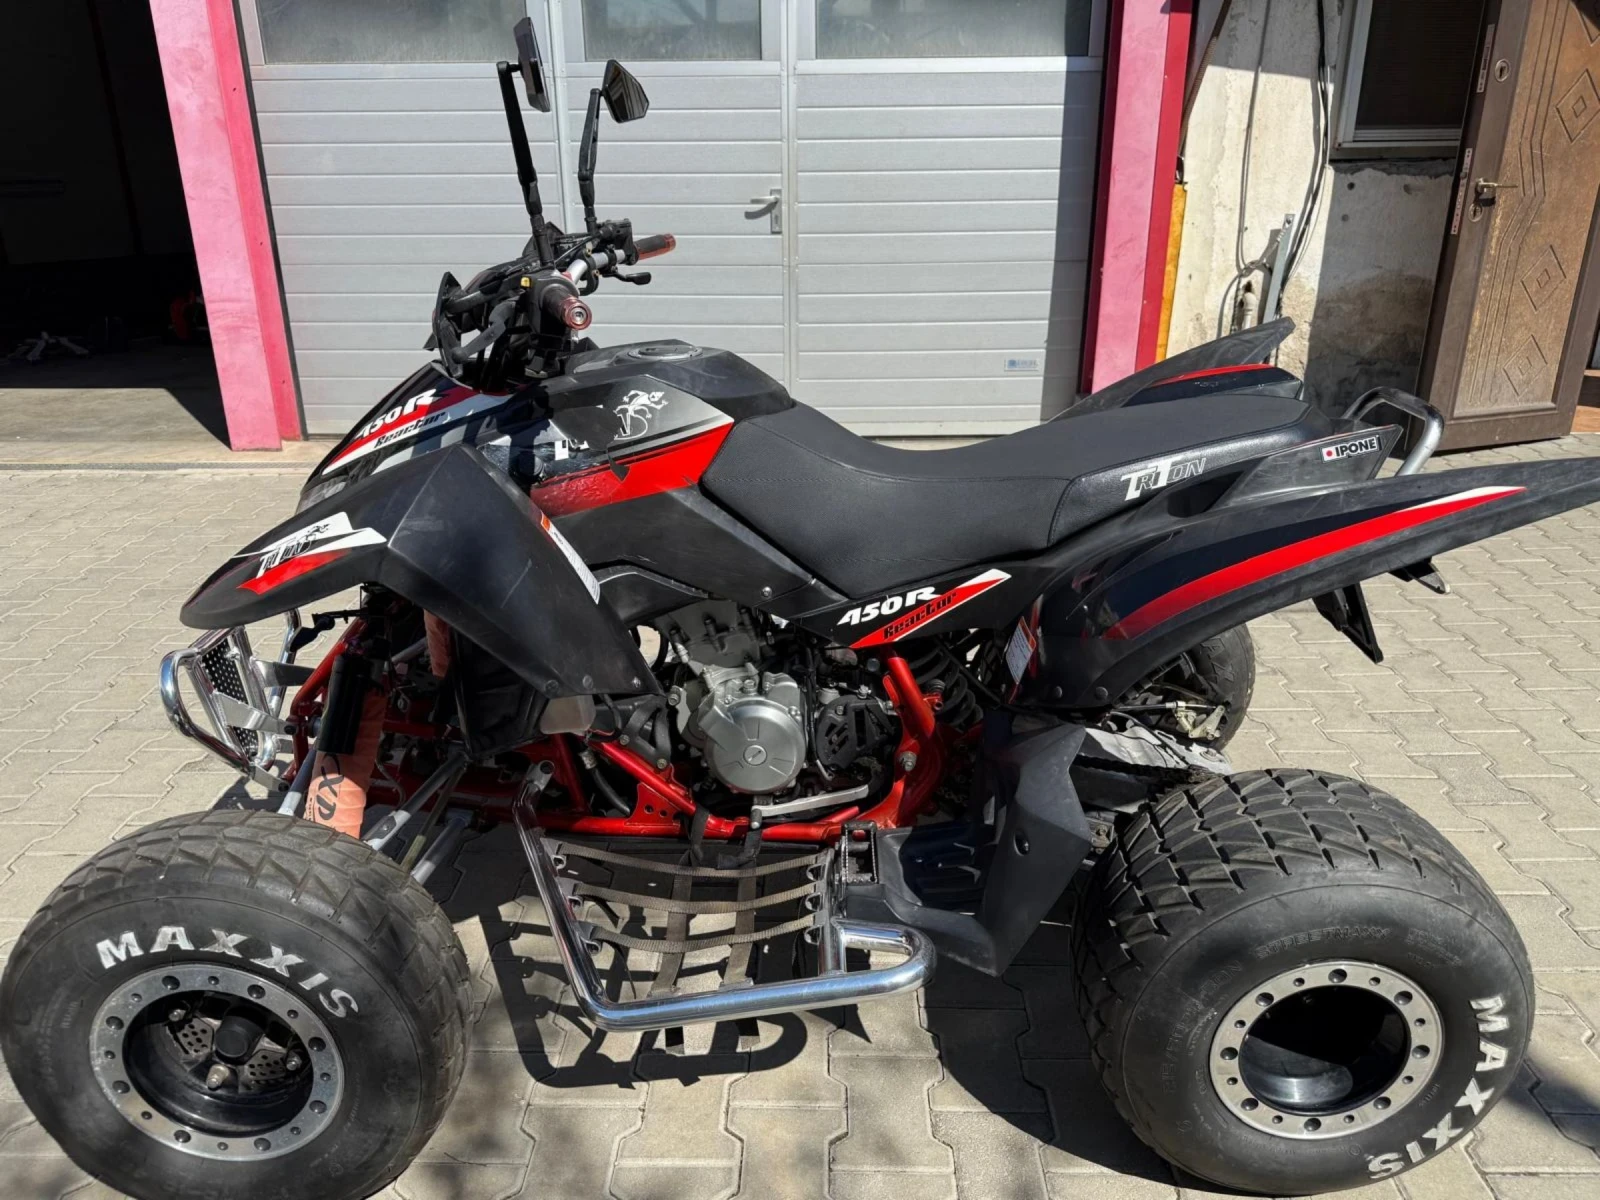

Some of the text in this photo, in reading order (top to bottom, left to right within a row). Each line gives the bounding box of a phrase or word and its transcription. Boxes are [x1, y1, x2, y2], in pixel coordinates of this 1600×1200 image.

[1335, 437, 1377, 457] IPONE
[837, 586, 942, 626] 450R
[883, 592, 957, 640] Reactor
[96, 926, 360, 1019] MAXXIS
[1366, 997, 1509, 1179] MAXXIS
